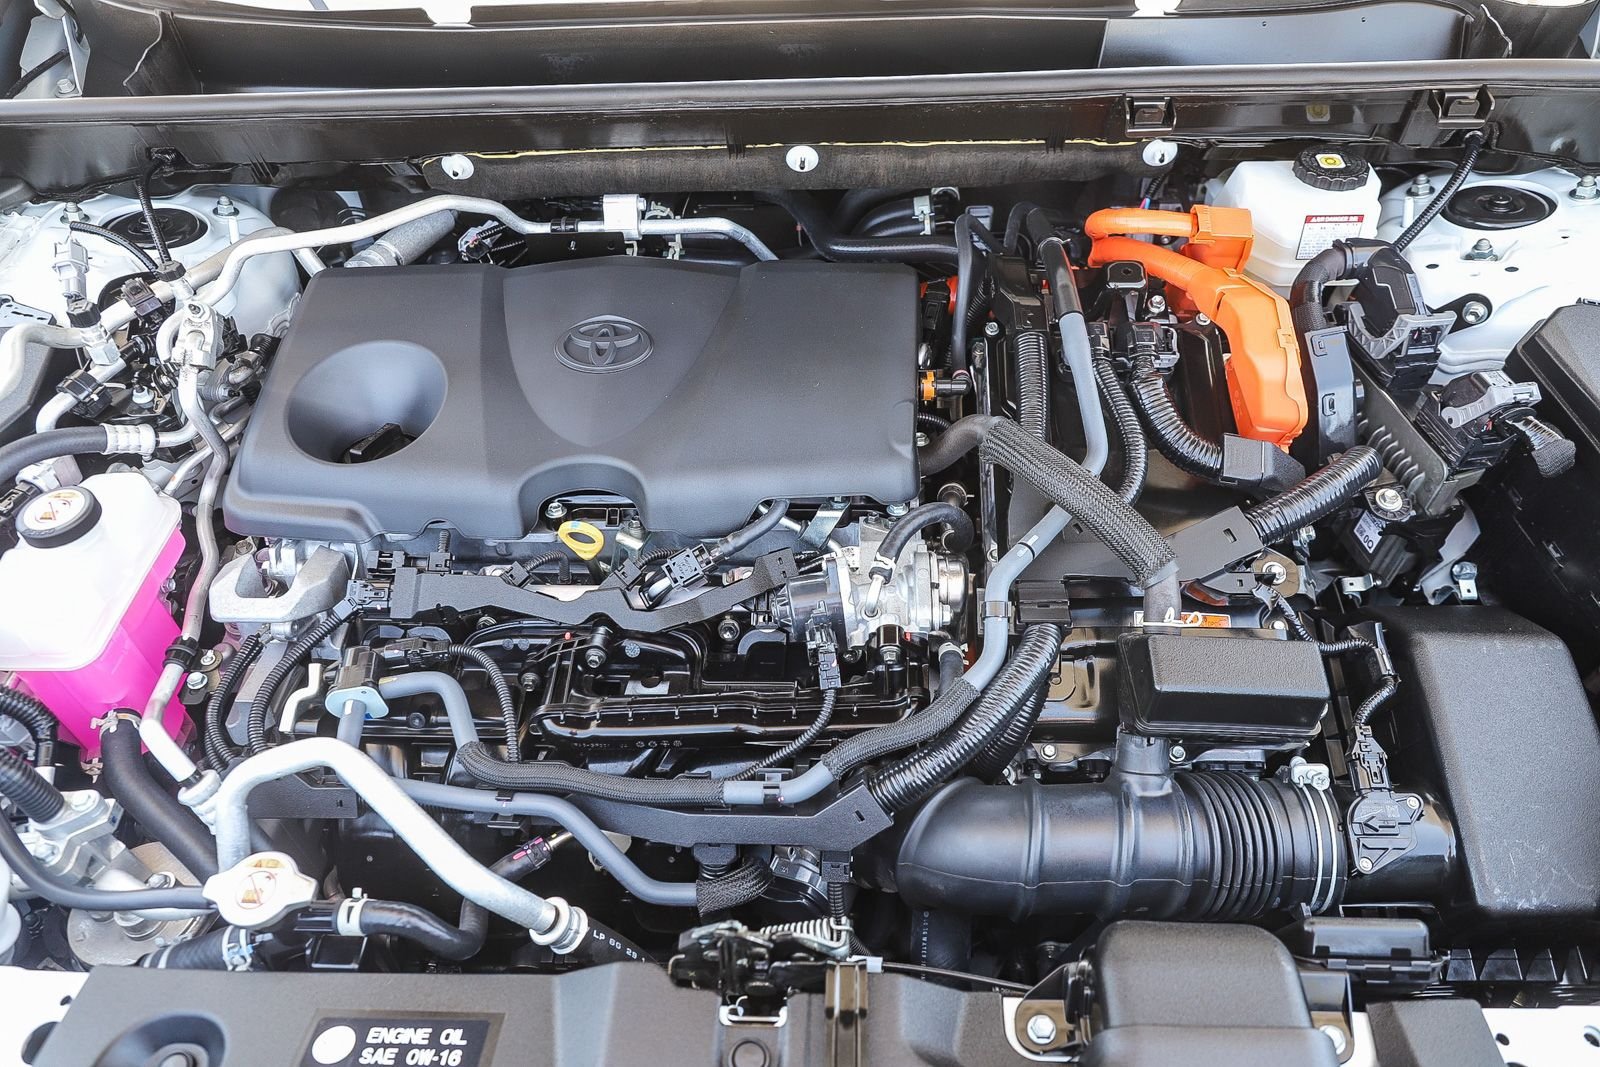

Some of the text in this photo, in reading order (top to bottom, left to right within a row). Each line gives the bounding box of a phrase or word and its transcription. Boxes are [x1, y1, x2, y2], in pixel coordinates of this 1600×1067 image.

[593, 930, 605, 940] LP
[366, 1027, 468, 1046] ENGINE OIL
[358, 1048, 463, 1067] SAE 0W-16
